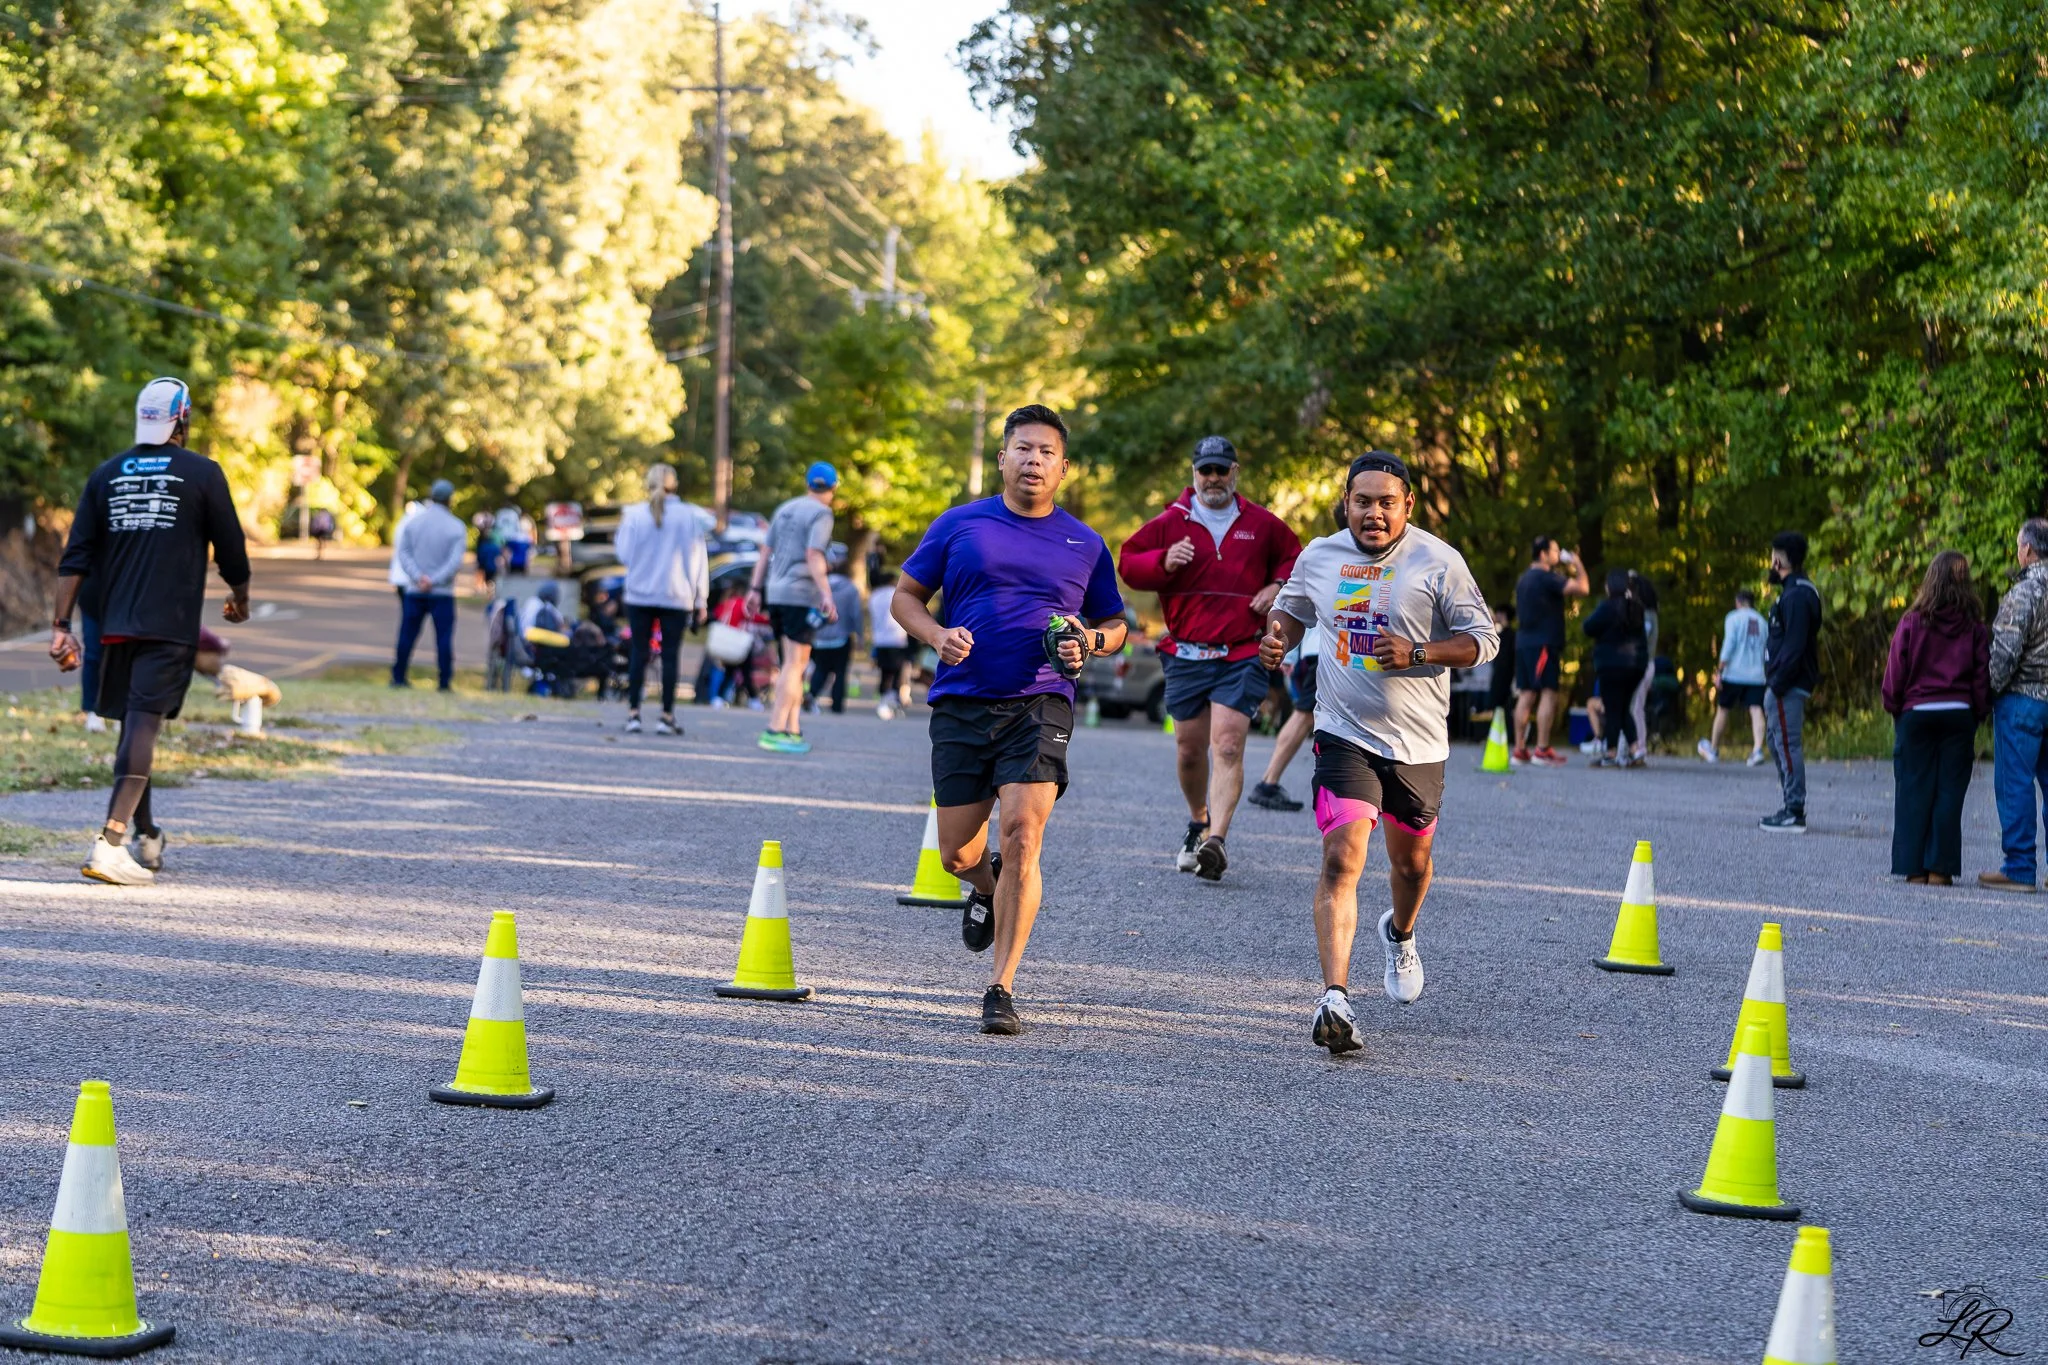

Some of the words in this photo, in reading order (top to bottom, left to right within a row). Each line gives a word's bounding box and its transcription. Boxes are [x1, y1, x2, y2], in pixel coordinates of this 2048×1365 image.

[1340, 564, 1382, 581] COOPER
[1377, 581, 1393, 610] YOUNG
[1336, 630, 1350, 667] 4
